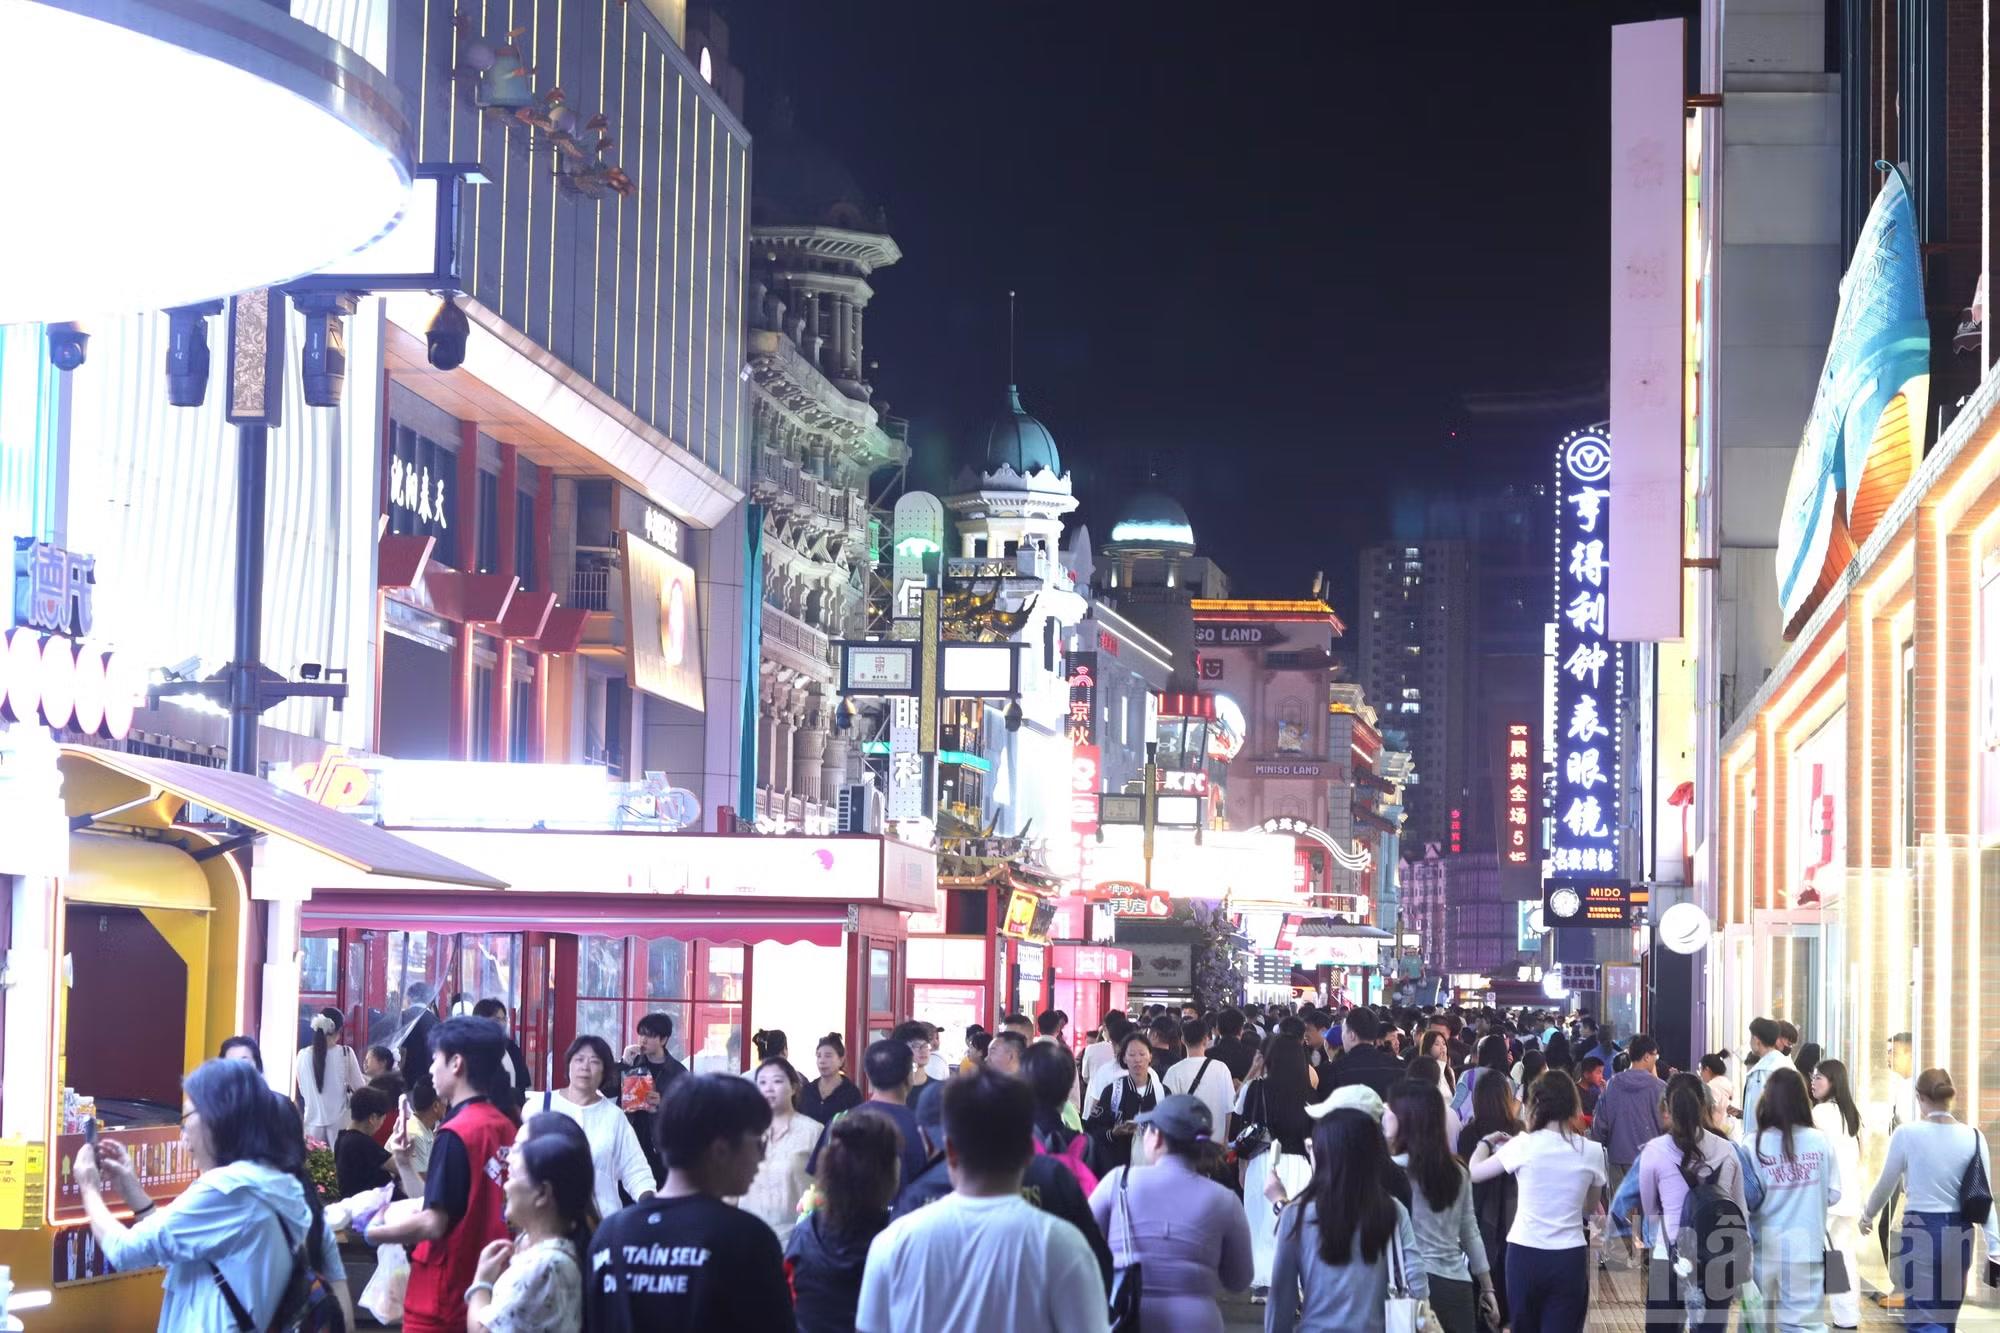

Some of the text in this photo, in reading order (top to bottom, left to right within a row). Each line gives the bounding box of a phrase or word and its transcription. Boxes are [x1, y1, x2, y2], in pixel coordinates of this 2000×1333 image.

[1221, 628, 1263, 642] LAND
[1562, 486, 1612, 838] 亨得利钟表眼镜
[1255, 765, 1320, 776] MINISO LAND
[1164, 770, 1207, 792] KFC
[1590, 887, 1621, 898] MIDO
